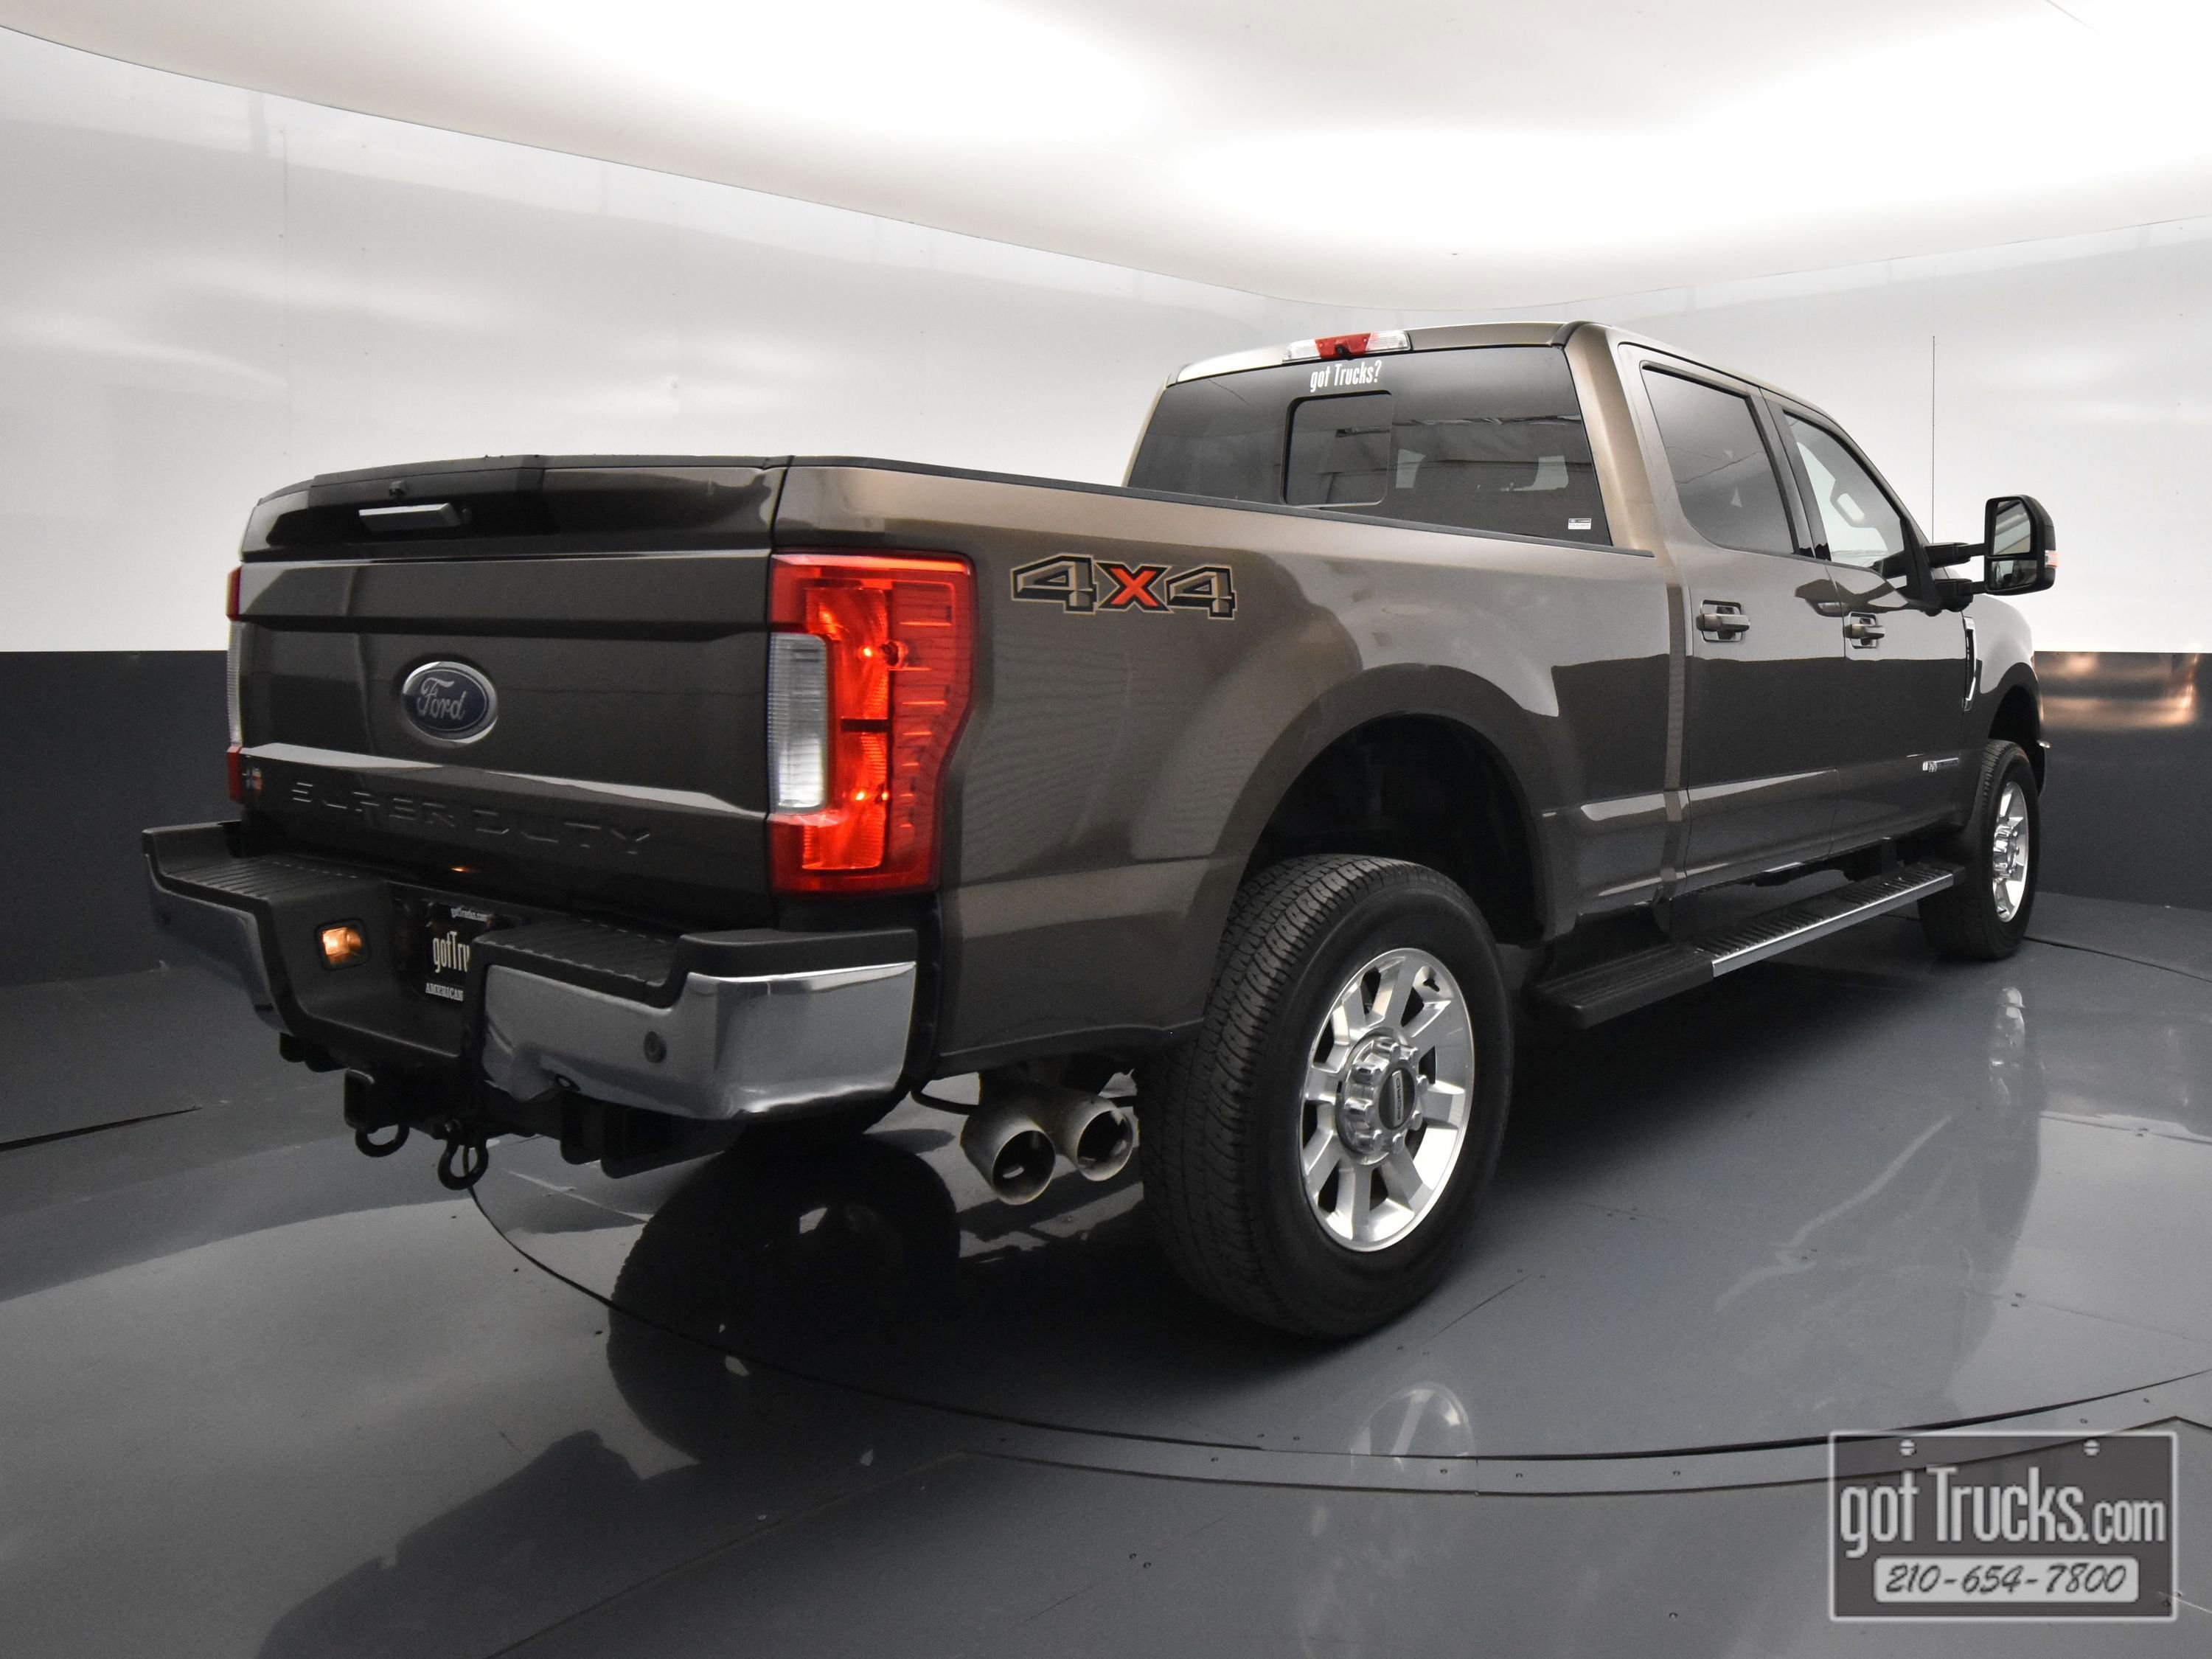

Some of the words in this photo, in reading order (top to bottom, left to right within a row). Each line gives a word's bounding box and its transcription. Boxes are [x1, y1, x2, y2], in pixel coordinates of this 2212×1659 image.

[1310, 365, 1330, 393] got
[1334, 359, 1382, 386] Trucks?
[417, 677, 467, 720] Ford
[472, 810, 651, 855] DUTY
